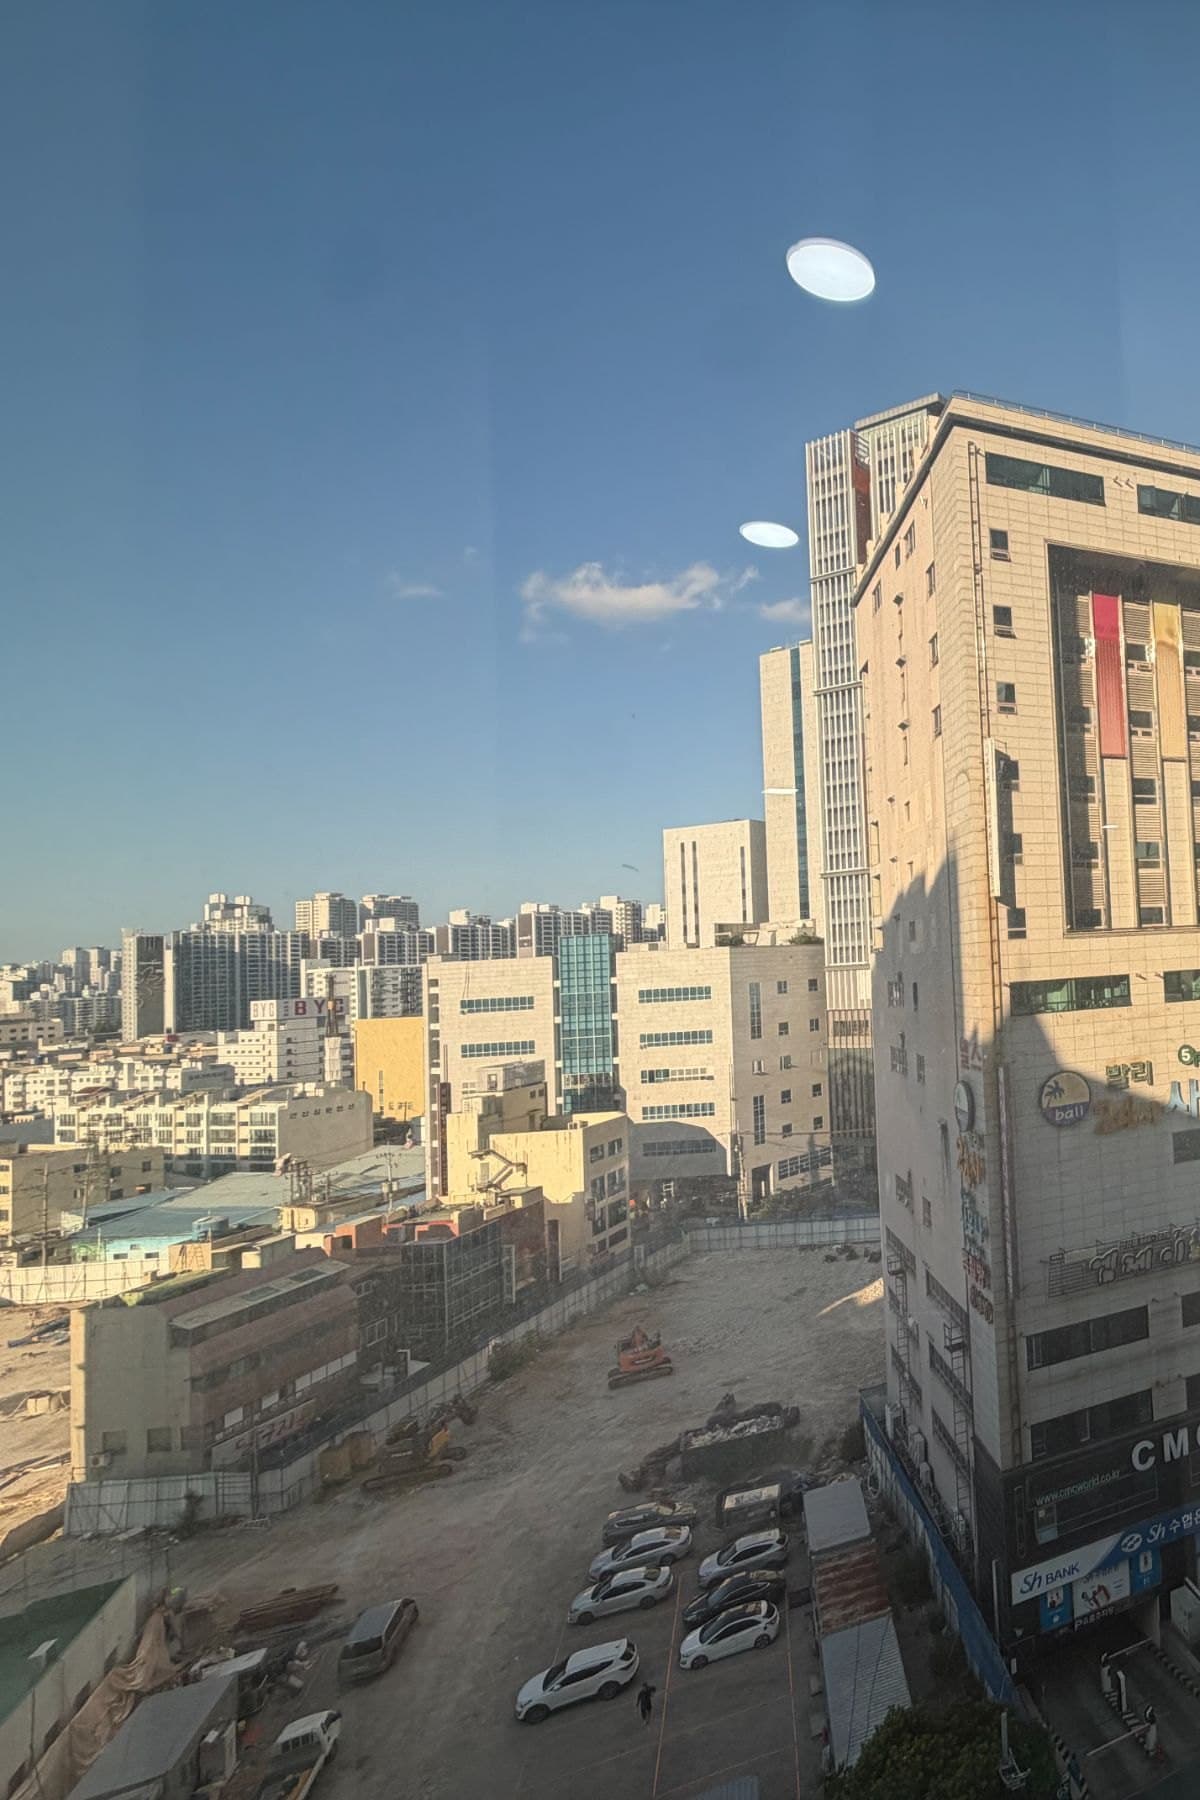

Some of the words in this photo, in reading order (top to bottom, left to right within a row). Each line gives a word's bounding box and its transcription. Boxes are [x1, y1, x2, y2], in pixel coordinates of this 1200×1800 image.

[1105, 1060, 1154, 1089] 발리
[1146, 1523, 1166, 1544] Sh
[1019, 1571, 1043, 1595] Sh
[1046, 1562, 1080, 1586] BANK
